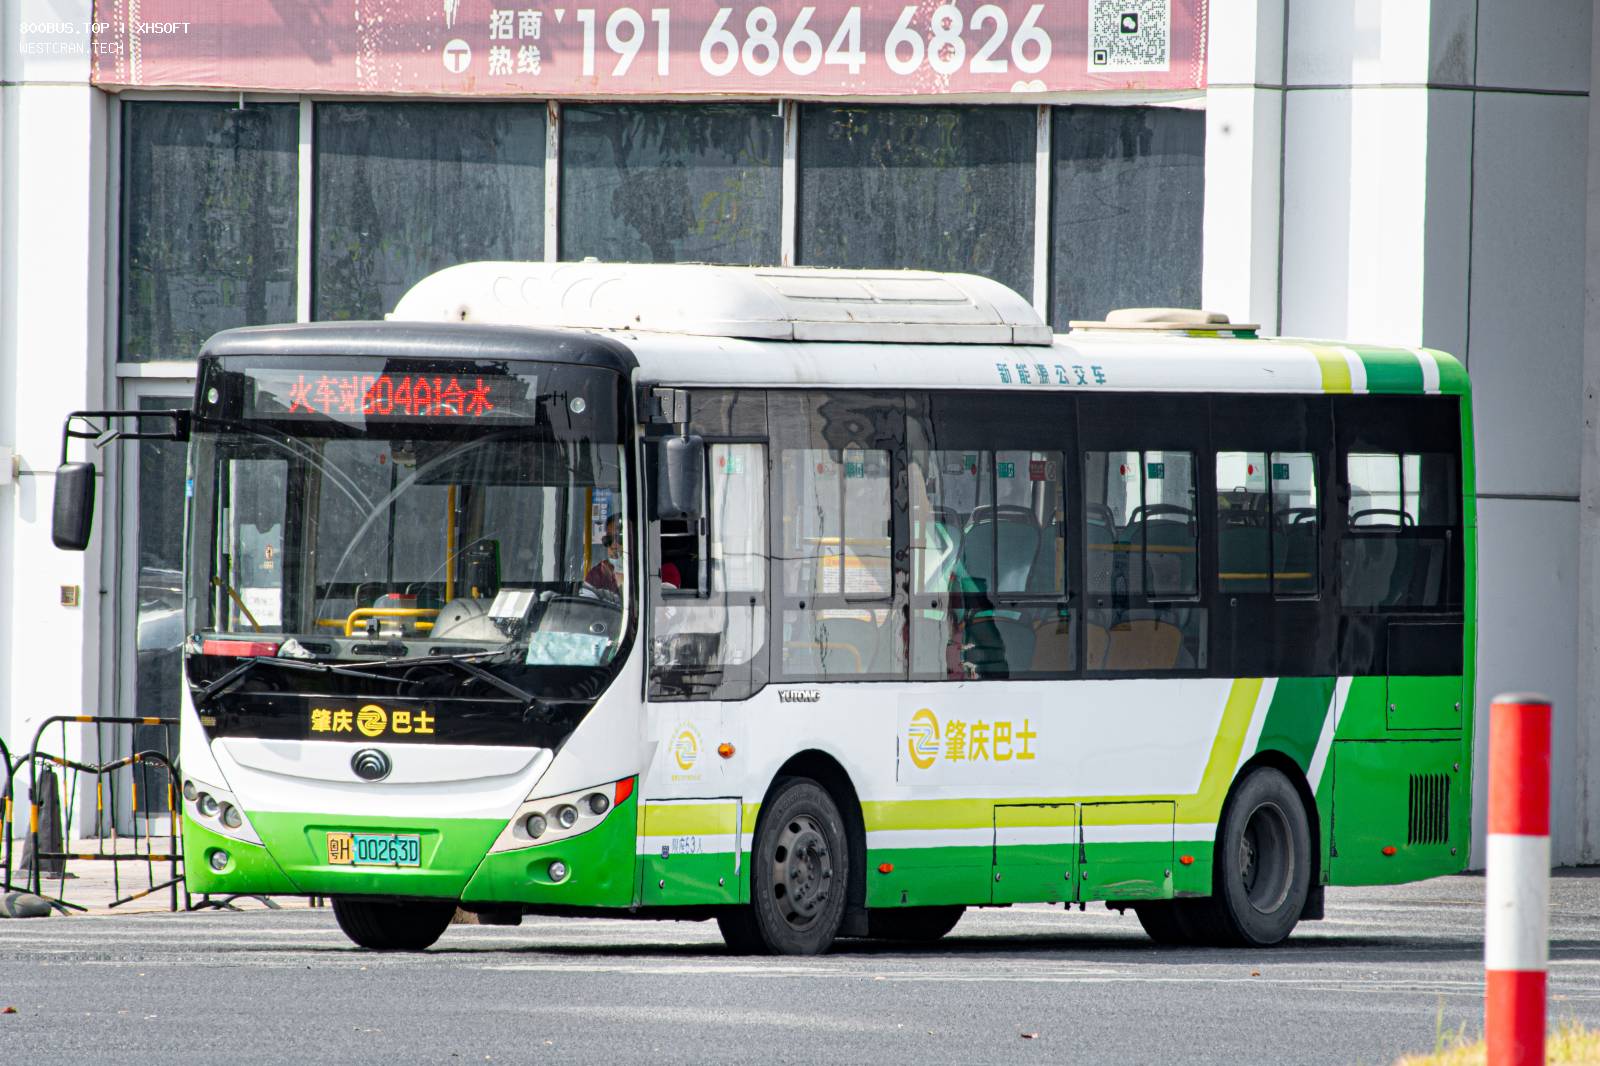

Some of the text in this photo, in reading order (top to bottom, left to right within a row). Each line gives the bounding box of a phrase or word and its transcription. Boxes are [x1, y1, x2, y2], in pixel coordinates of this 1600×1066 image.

[489, 8, 543, 40] 招商
[576, 3, 1052, 77] 191 6864 6826
[488, 45, 543, 76] 热线
[996, 363, 1107, 385] 新能源公交车
[311, 708, 435, 734] 肇庆 巴士
[945, 719, 1037, 762] 肇庆巴士
